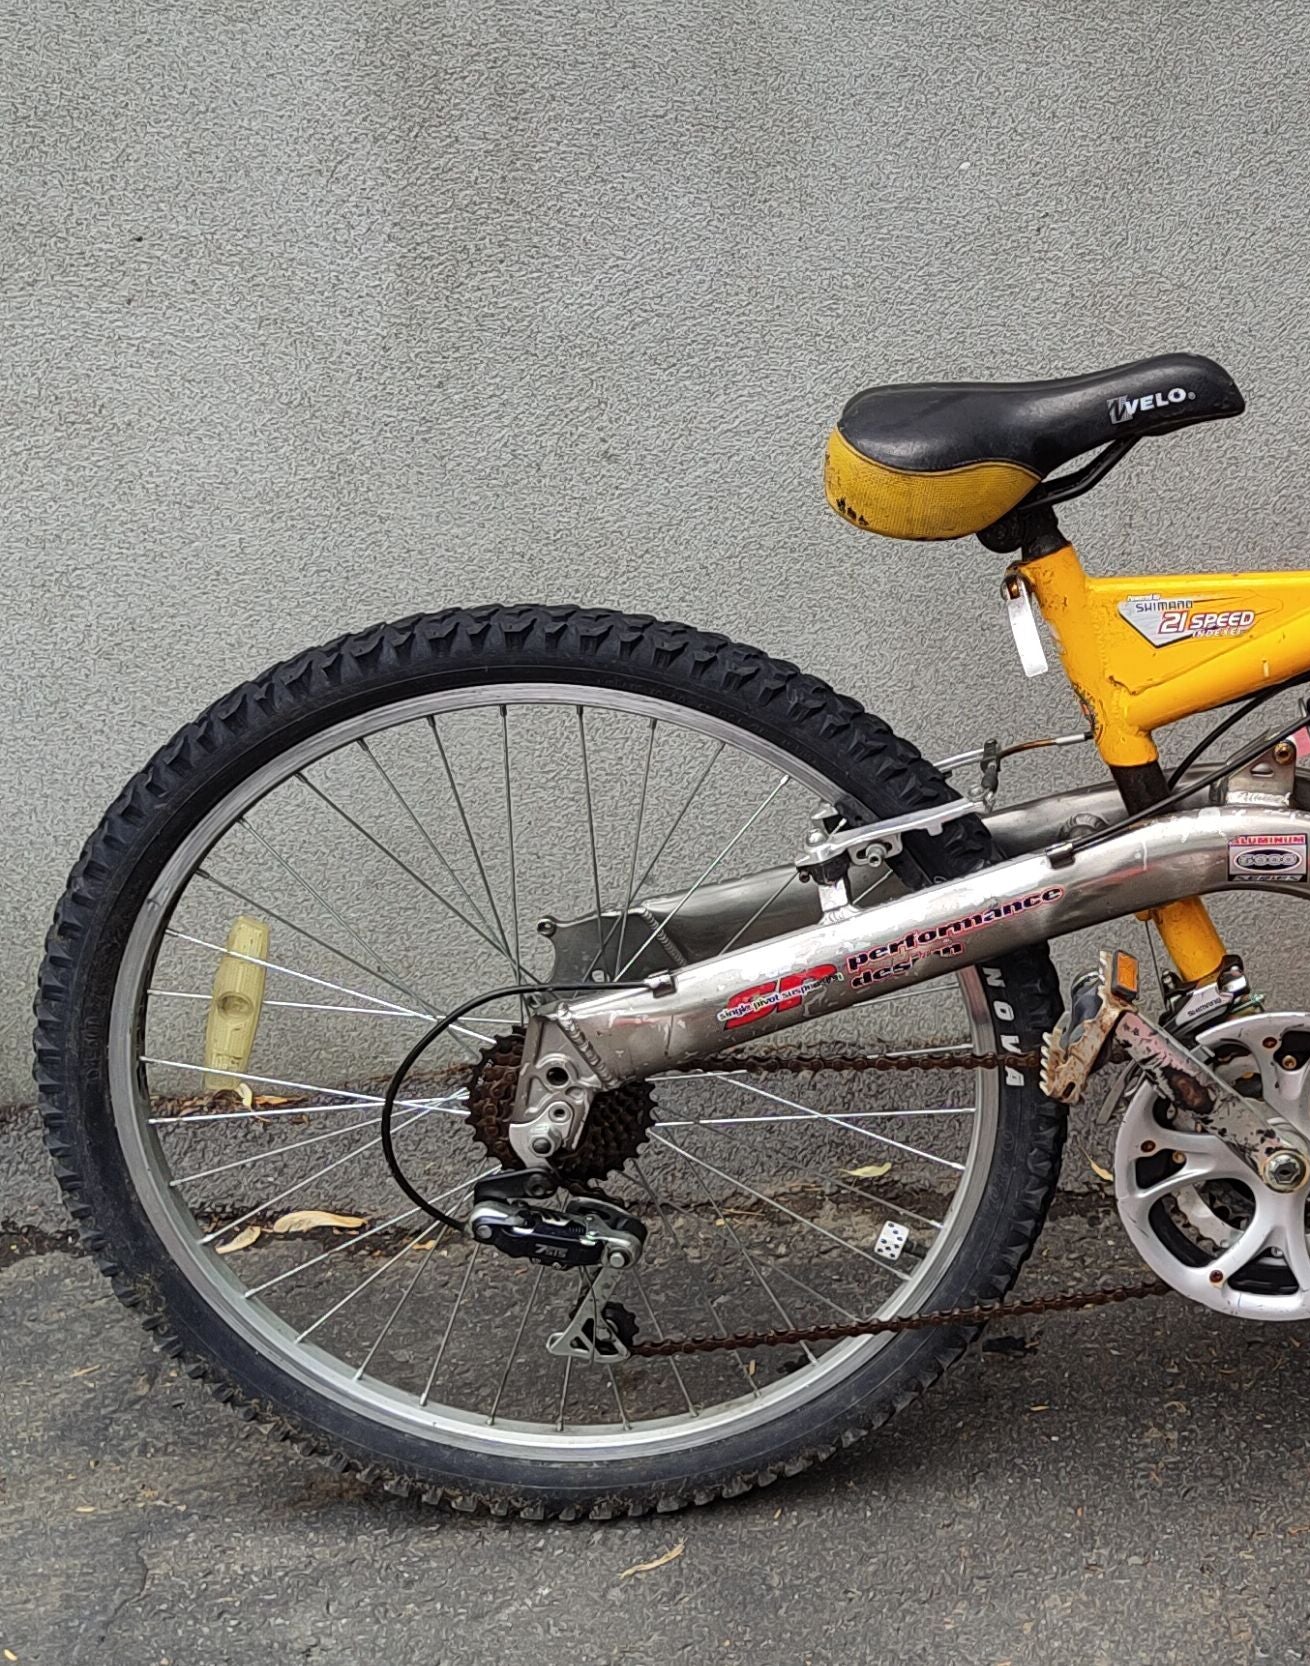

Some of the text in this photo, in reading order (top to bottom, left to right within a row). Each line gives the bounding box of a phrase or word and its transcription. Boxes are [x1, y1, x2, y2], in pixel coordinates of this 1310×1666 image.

[1135, 600, 1193, 612] SHIMANO
[1159, 611, 1254, 633] 21 SPEED
[847, 884, 1064, 973] performance
[851, 942, 965, 989] desn
